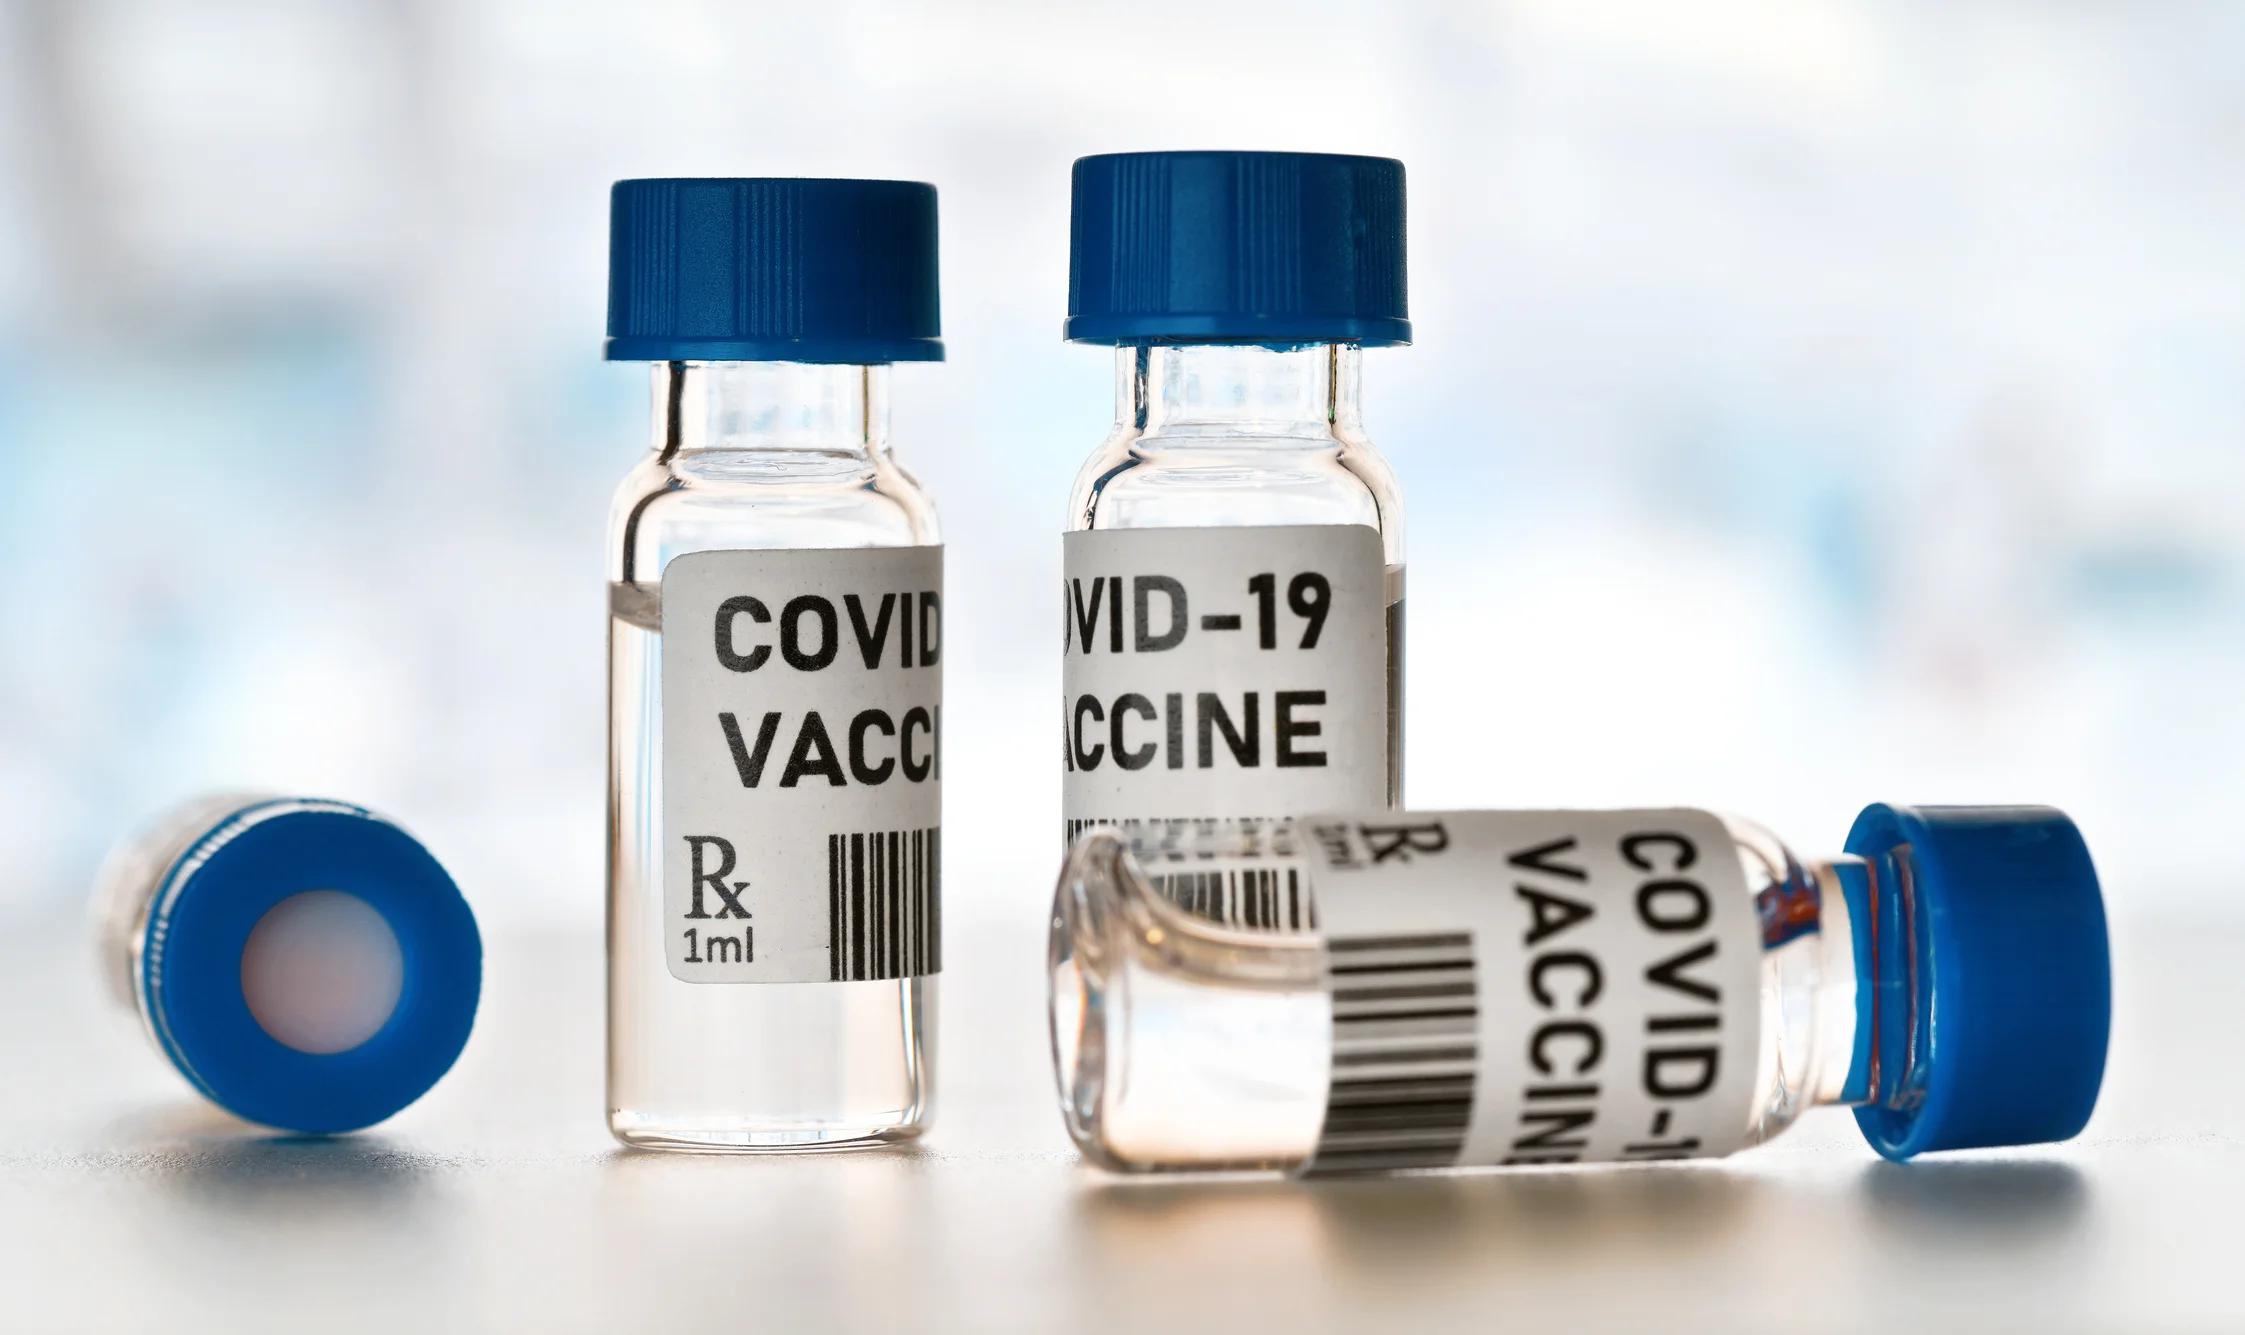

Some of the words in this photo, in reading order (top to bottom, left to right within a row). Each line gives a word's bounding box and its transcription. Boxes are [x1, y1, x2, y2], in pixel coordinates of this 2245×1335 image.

[714, 590, 942, 673] COVID
[683, 926, 754, 964] 1ml
[1615, 830, 1723, 1161] COVID-1
